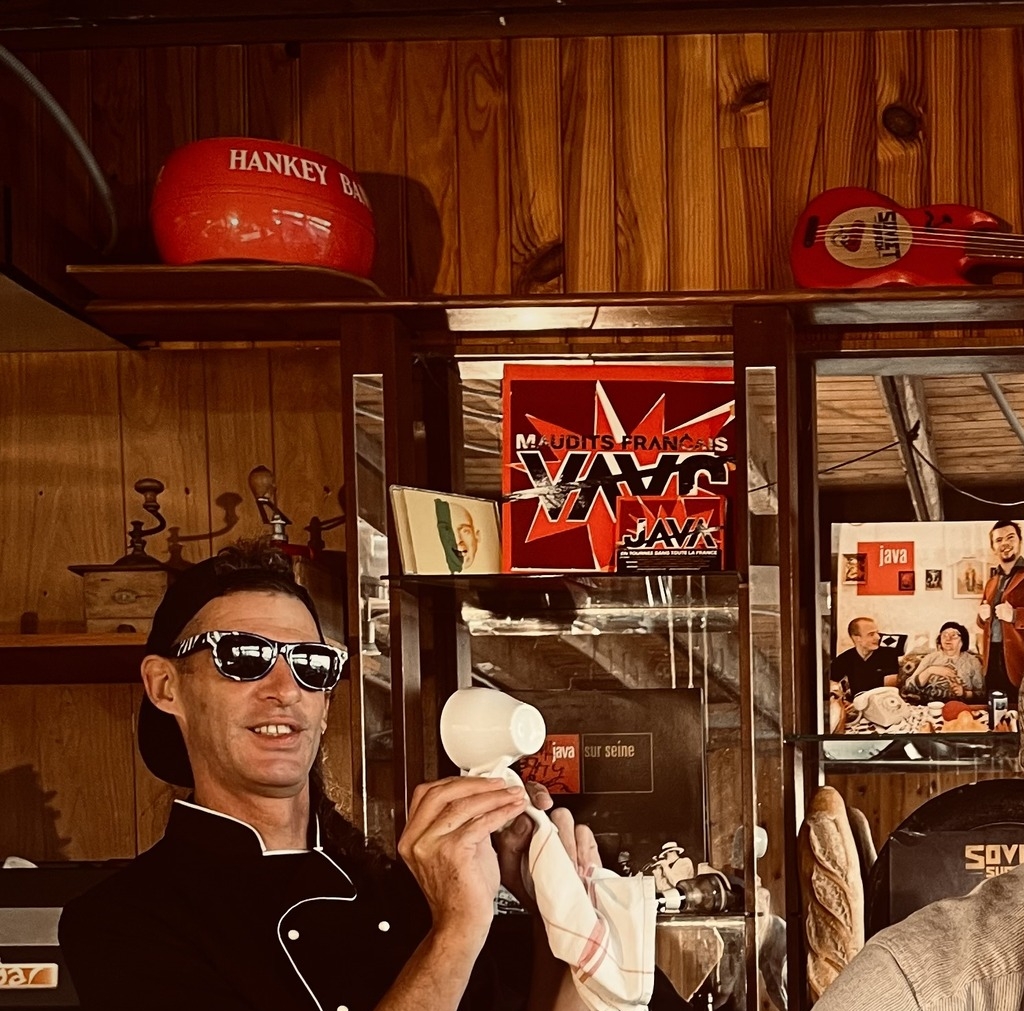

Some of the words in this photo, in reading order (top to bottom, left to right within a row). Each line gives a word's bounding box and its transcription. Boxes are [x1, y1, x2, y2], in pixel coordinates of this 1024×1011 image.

[229, 149, 328, 186] HANKEY
[516, 433, 614, 450] MAUDITS
[621, 517, 719, 550] JAVA
[879, 545, 908, 567] java
[552, 742, 576, 763] java
[584, 746, 602, 758] sur
[605, 740, 635, 758] seine
